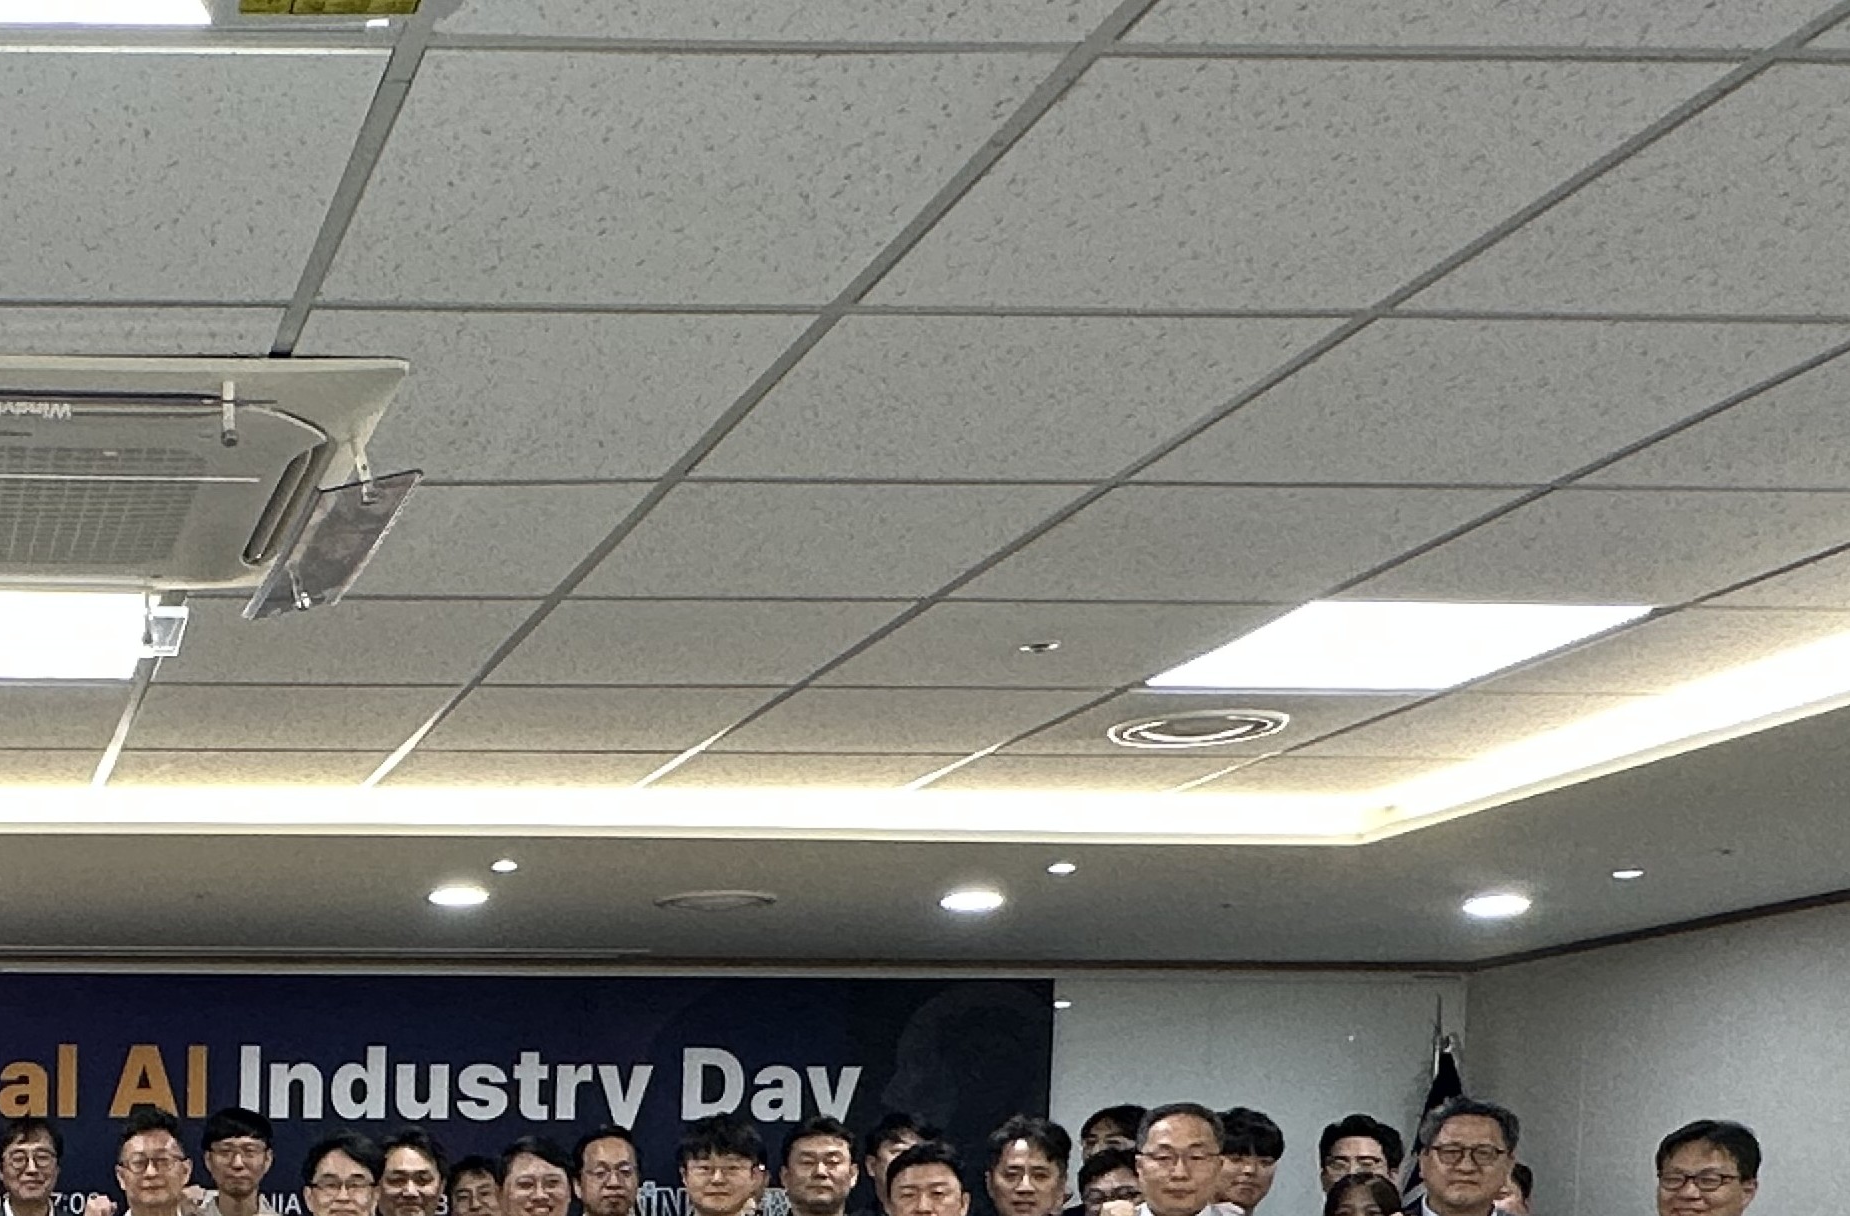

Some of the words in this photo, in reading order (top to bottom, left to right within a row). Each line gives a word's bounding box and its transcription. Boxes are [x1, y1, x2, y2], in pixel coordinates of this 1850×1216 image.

[108, 1044, 209, 1118] AI
[240, 1045, 654, 1131] Industry
[680, 1046, 862, 1124] Day
